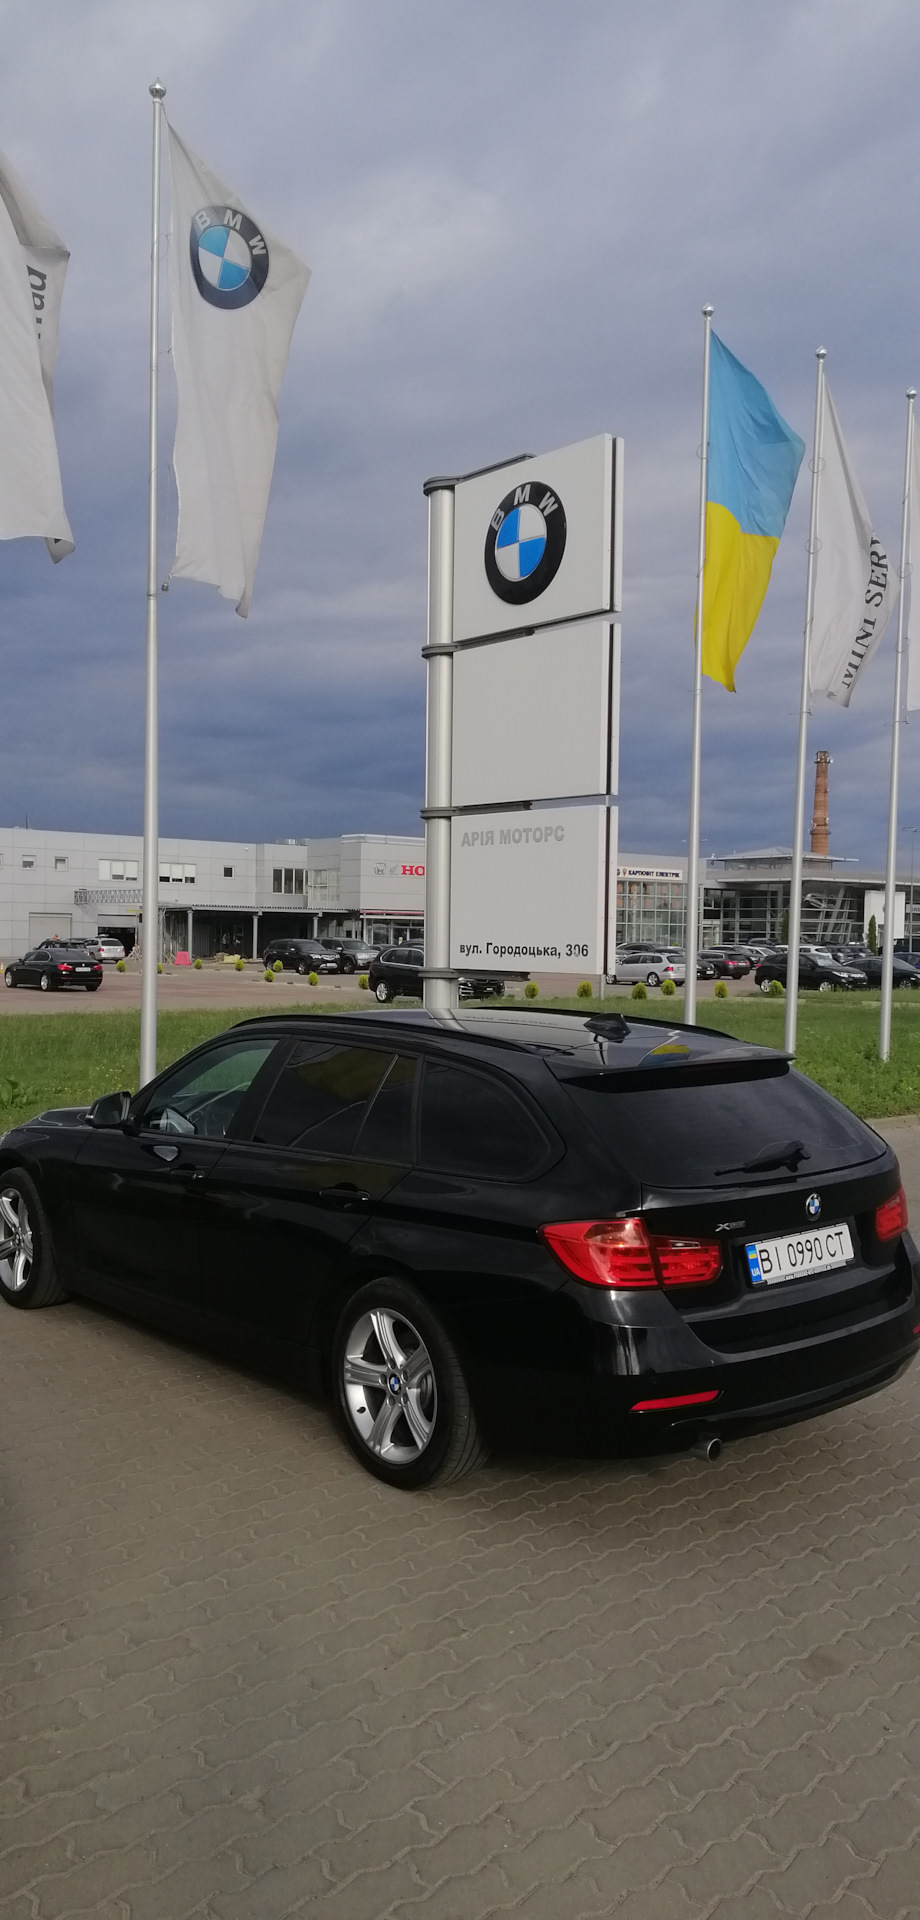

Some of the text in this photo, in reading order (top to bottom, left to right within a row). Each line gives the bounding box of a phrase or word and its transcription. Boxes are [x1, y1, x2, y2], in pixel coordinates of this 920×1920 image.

[195, 208, 267, 255] BMW
[490, 484, 559, 531] BMW
[461, 825, 565, 847] АРІЯ МОТОРС
[401, 864, 425, 876] HO
[459, 943, 482, 956] вул.
[486, 942, 561, 959] Городоцька,
[787, 1237, 823, 1268] 0990
[825, 1231, 844, 1258] CT
[751, 1267, 761, 1277] UA
